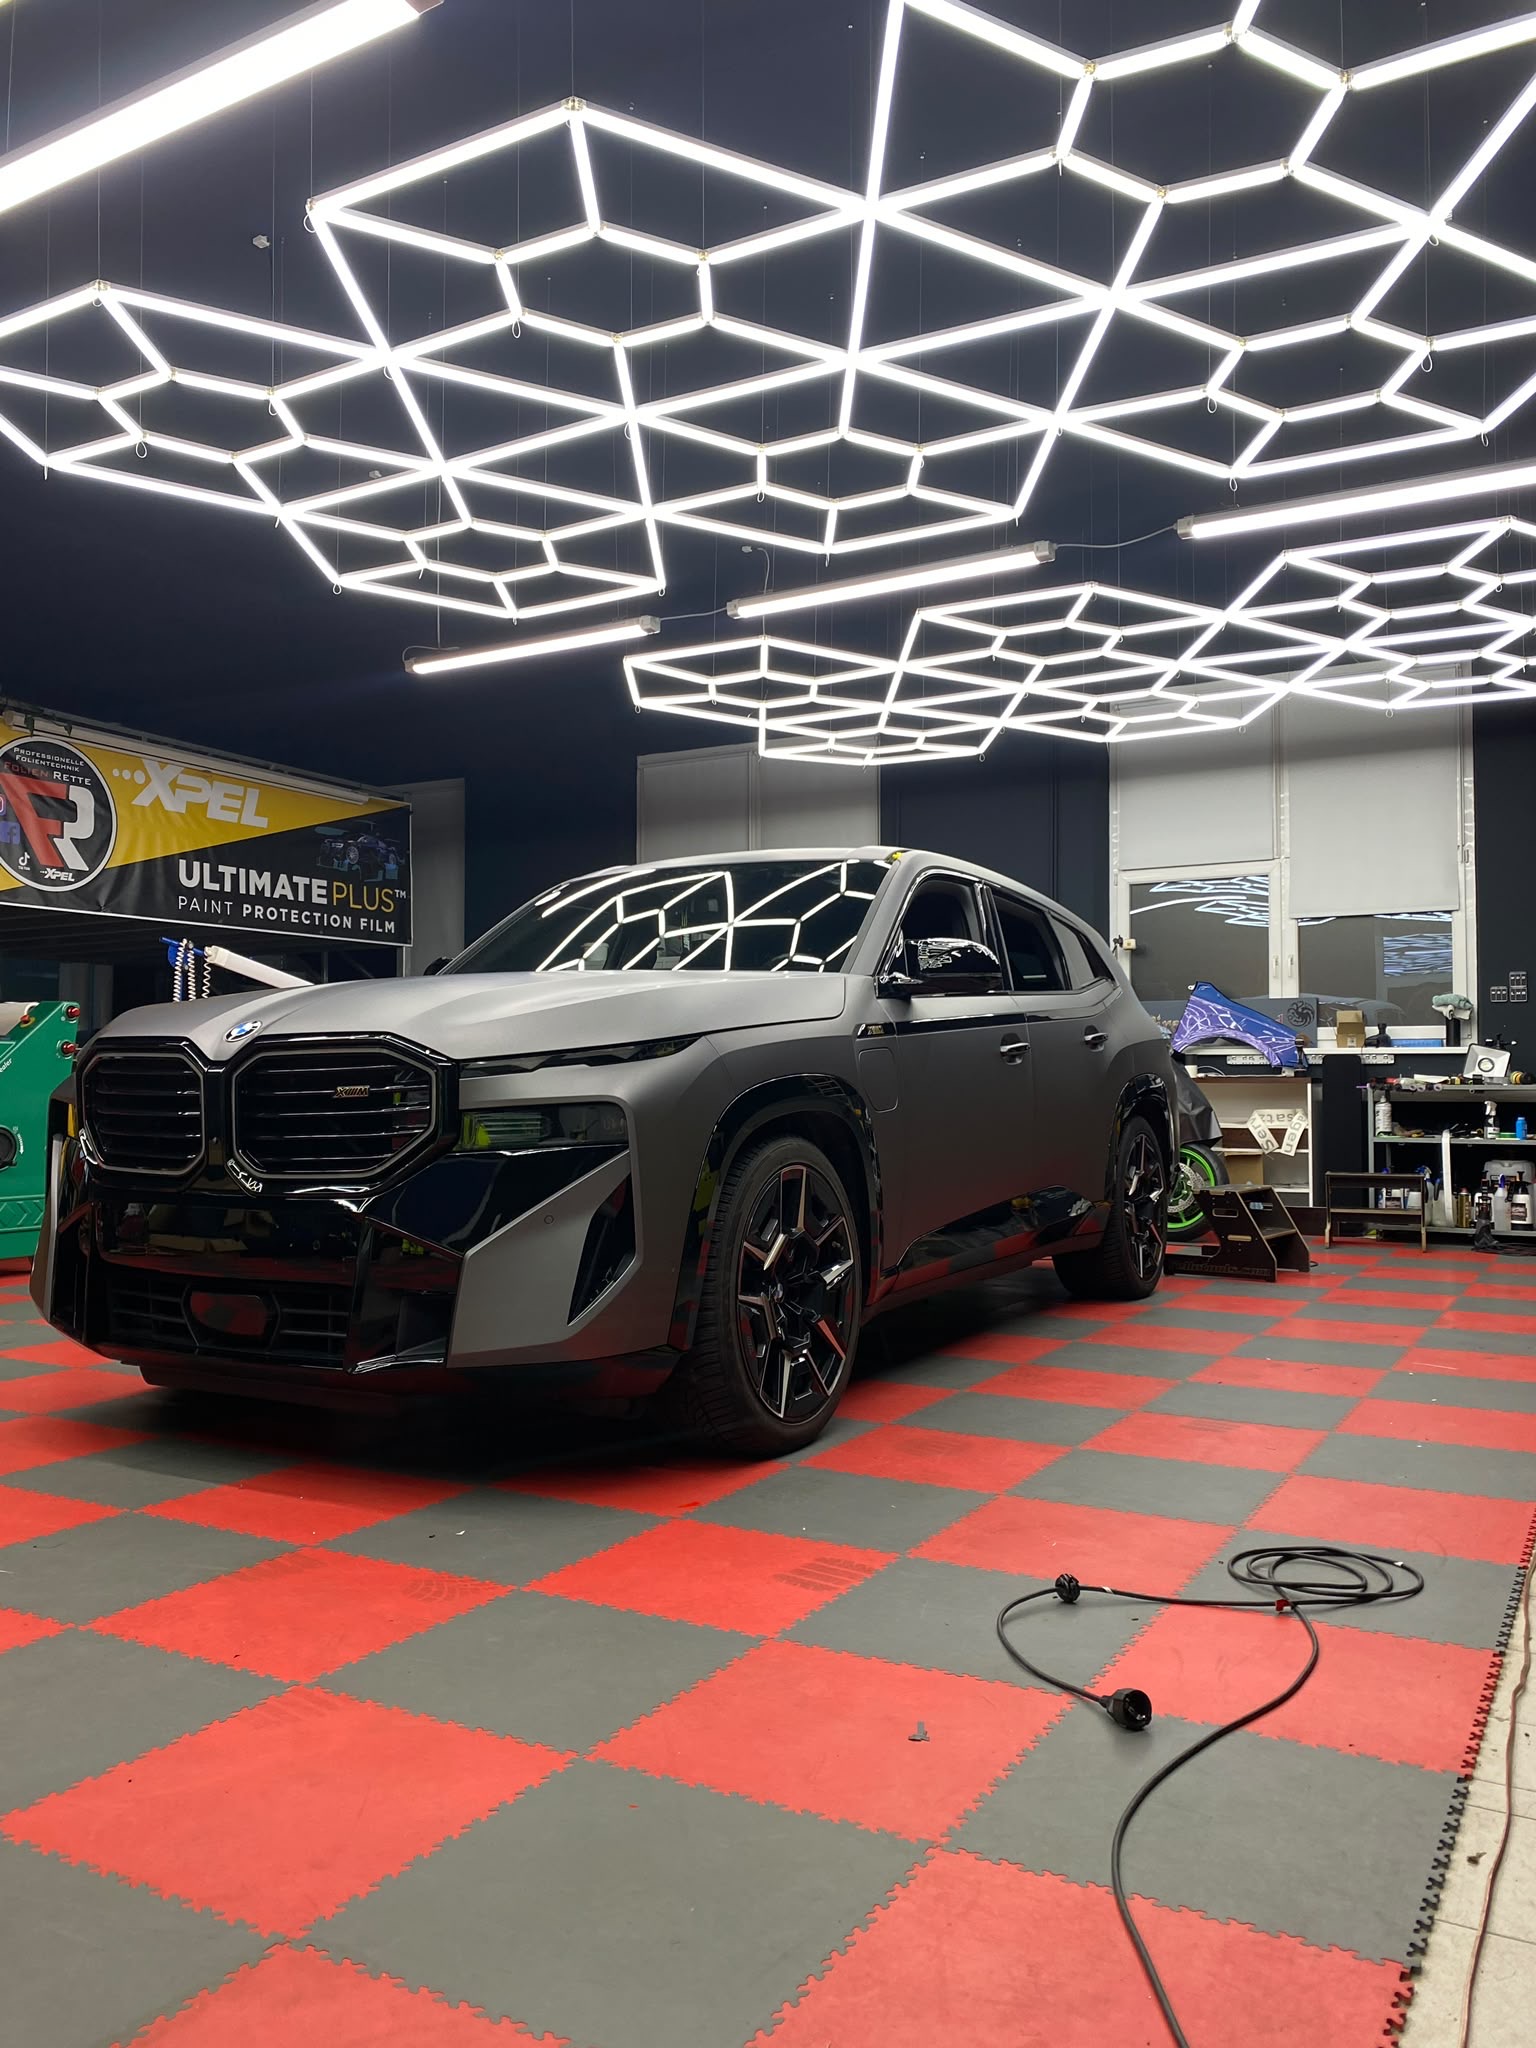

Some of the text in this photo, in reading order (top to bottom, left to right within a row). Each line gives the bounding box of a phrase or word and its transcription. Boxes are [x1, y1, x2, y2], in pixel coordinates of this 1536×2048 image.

[15, 754, 80, 773] FOLIENTECHNIK
[131, 758, 269, 829] XPEL
[44, 868, 75, 882] XPEL
[178, 858, 328, 905] ULTIMATE
[178, 895, 395, 934] PAINT PROTECTION FILM
